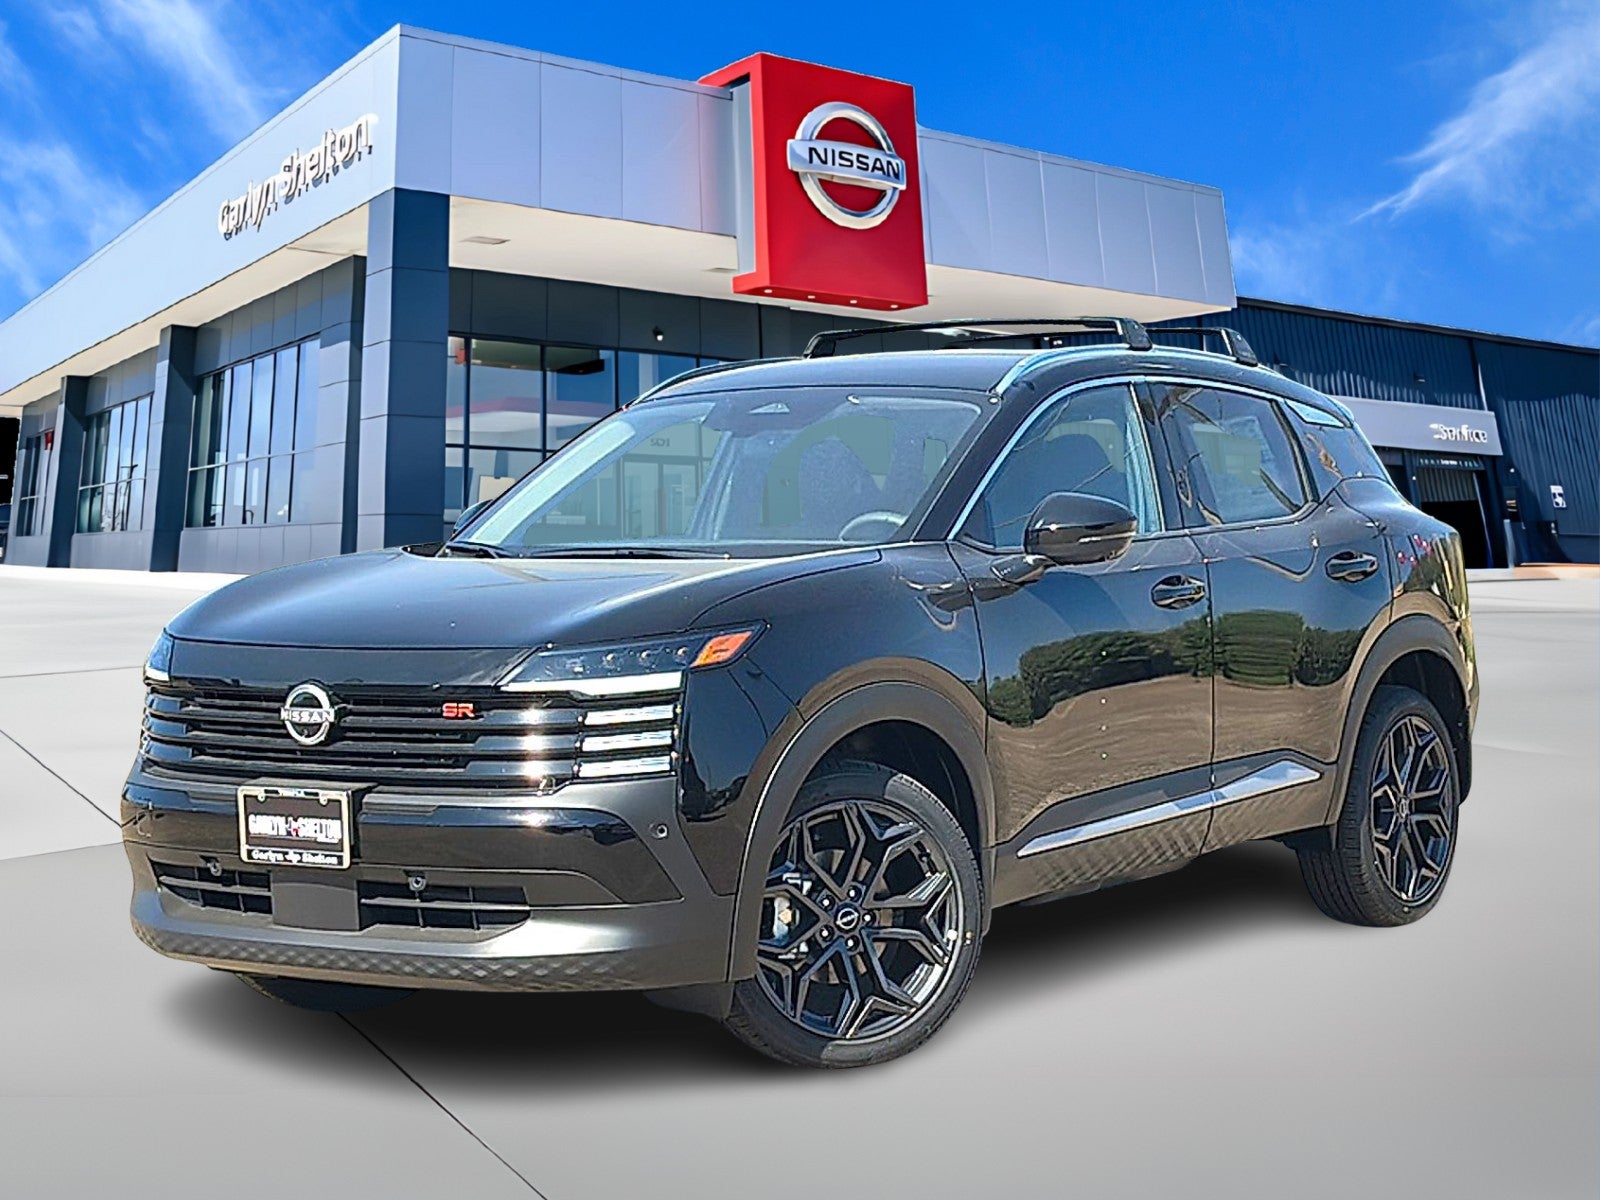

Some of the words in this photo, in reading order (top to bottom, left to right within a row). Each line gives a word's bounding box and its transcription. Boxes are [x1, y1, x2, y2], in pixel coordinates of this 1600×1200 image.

[808, 146, 900, 180] NISSAN
[280, 707, 334, 723] NISSAN
[442, 702, 474, 717] SR
